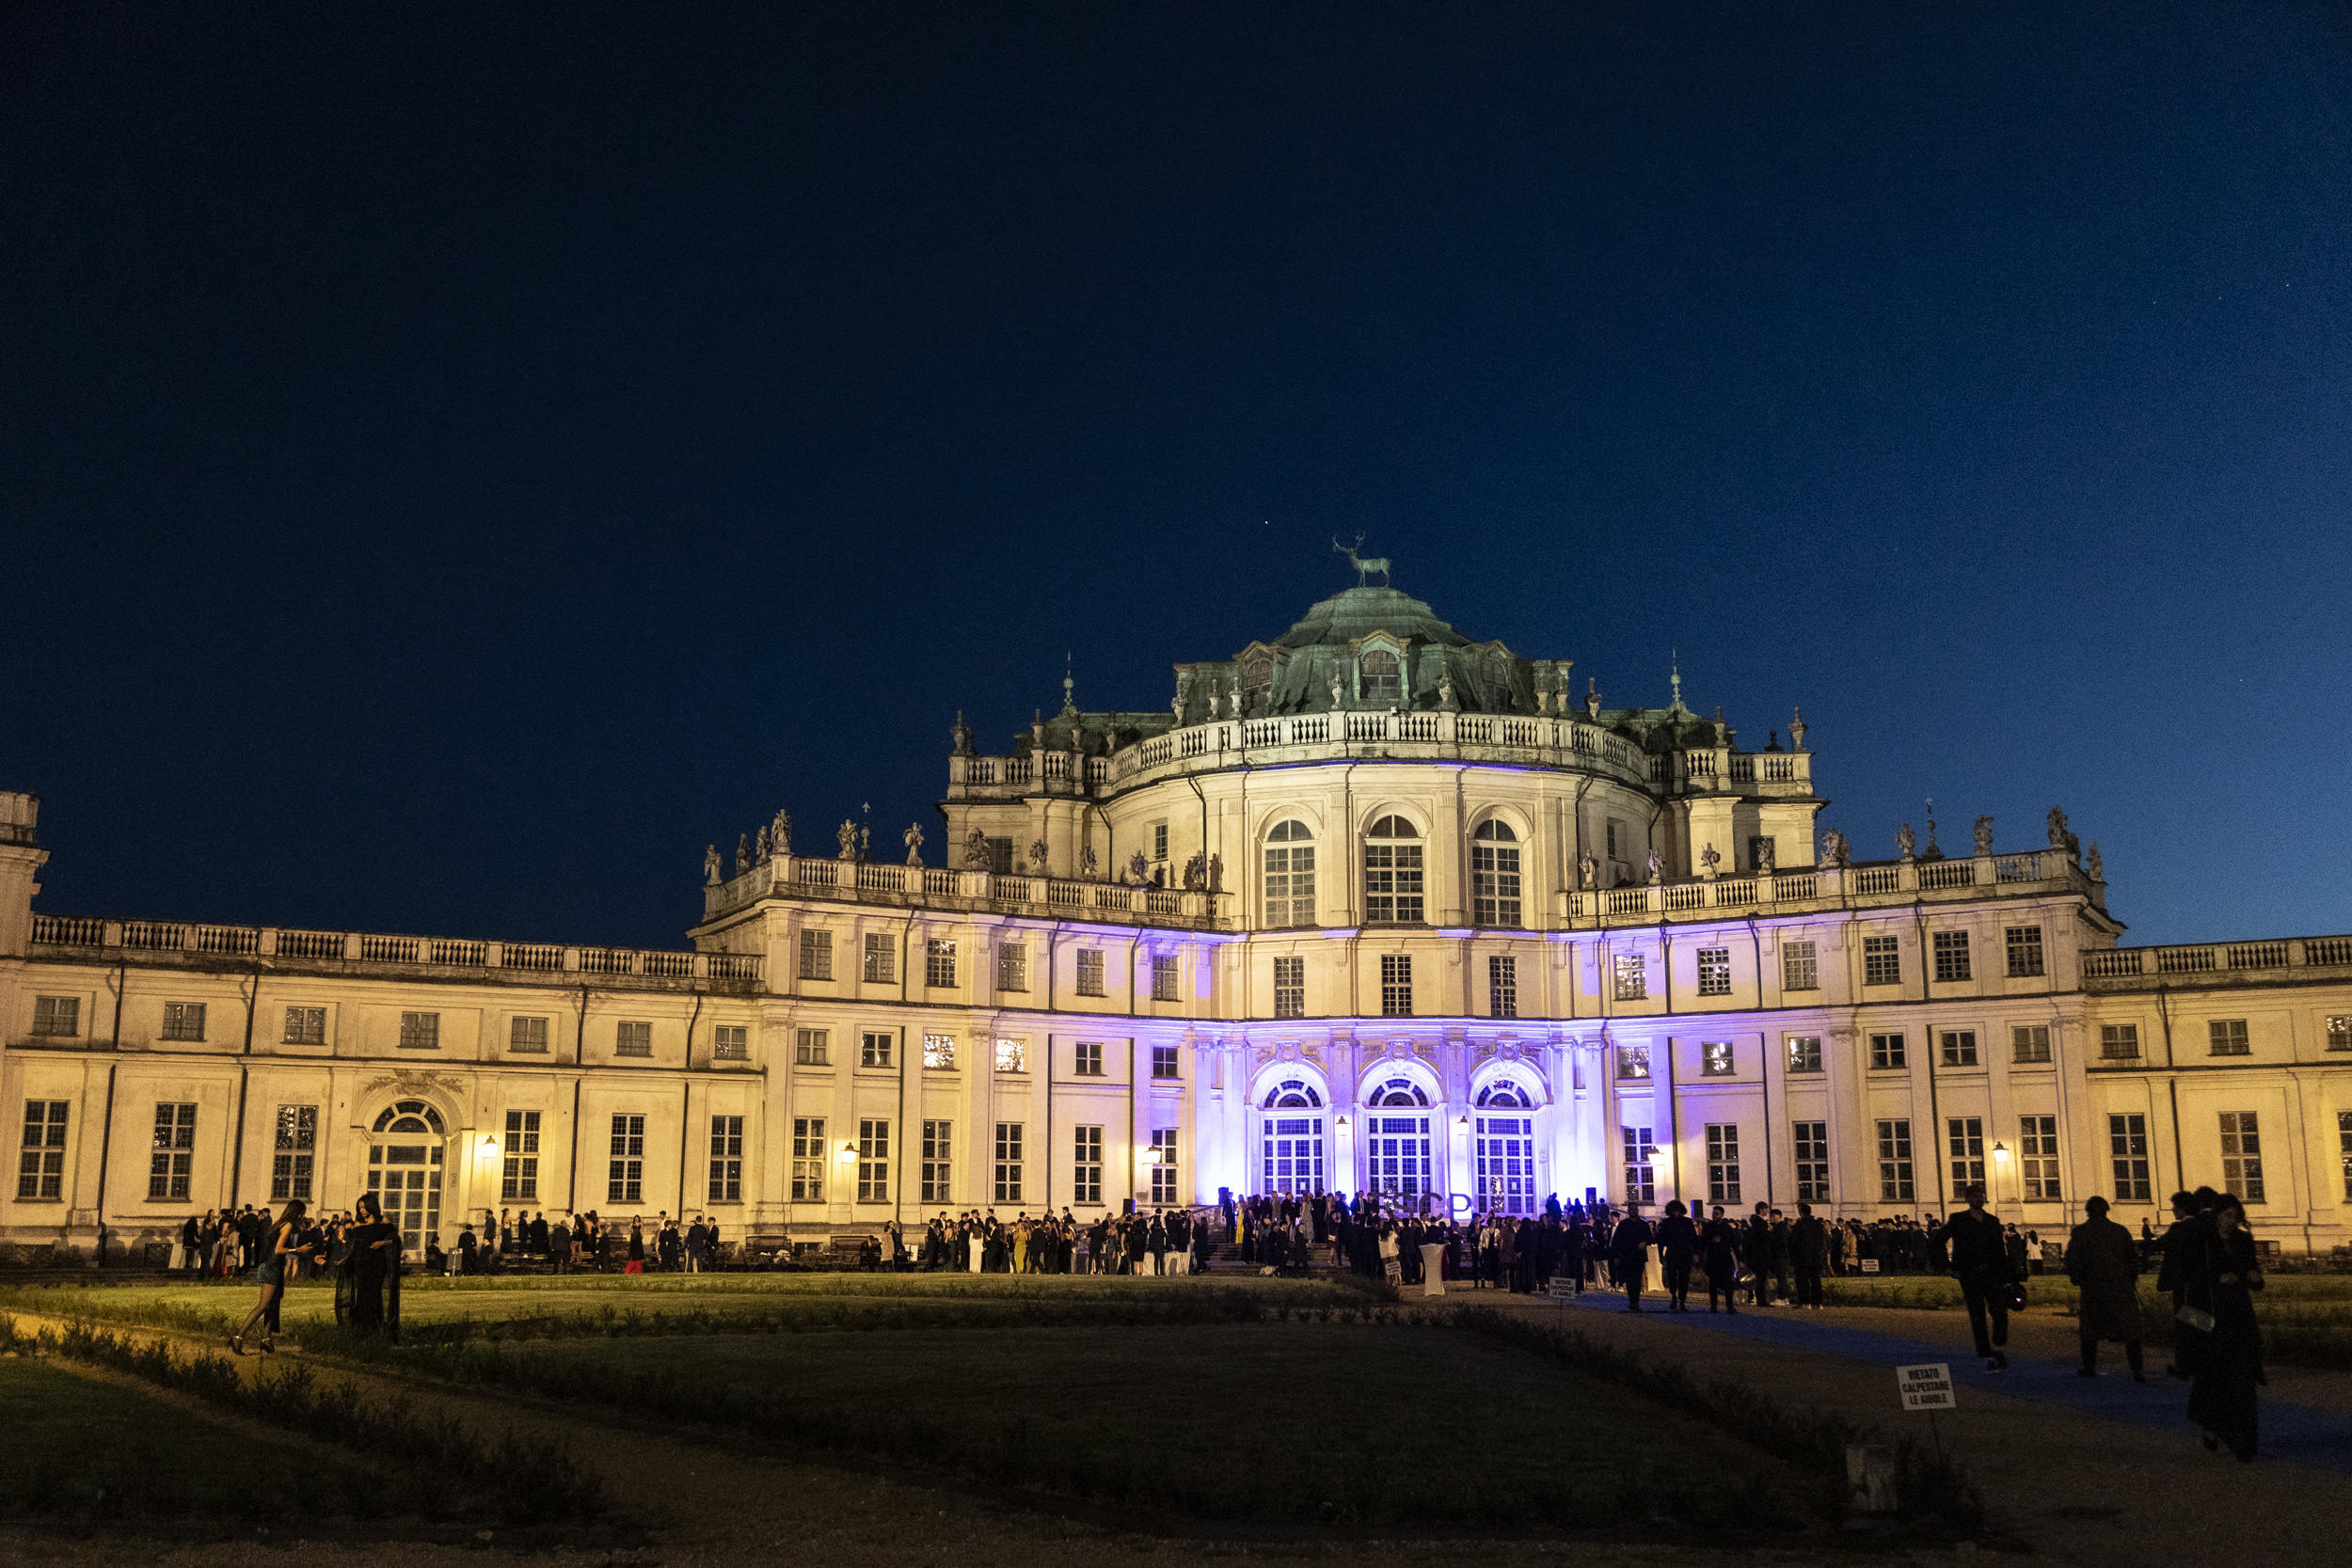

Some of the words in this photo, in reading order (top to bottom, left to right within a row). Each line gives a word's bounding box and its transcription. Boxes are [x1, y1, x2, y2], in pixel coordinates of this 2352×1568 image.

[1907, 1369, 1940, 1380] VIETATO
[1902, 1381, 1949, 1393] CALPESTARE
[1909, 1395, 1918, 1405] LE
